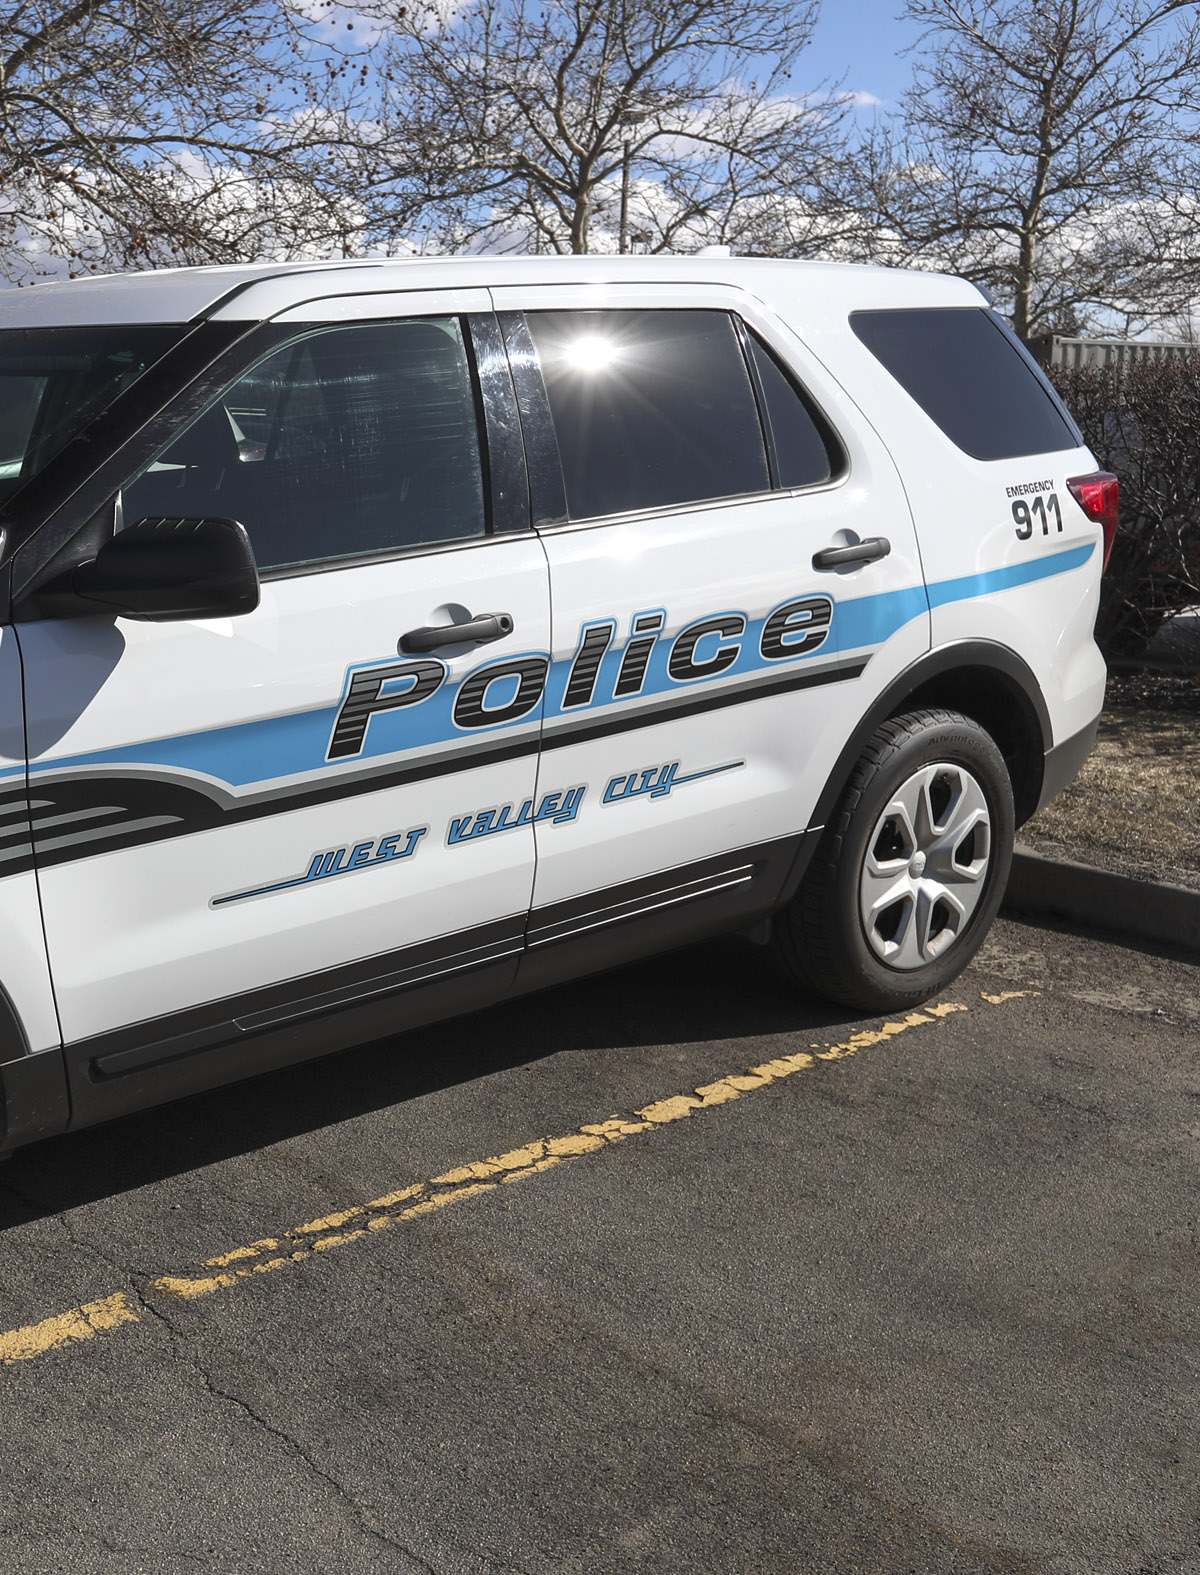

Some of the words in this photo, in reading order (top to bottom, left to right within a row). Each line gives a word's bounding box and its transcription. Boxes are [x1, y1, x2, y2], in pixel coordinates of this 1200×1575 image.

[1005, 479, 1055, 498] EMERGENCY
[1011, 493, 1063, 541] 911
[324, 597, 836, 762] Police
[304, 826, 428, 880] WEST
[602, 762, 686, 804] CITY
